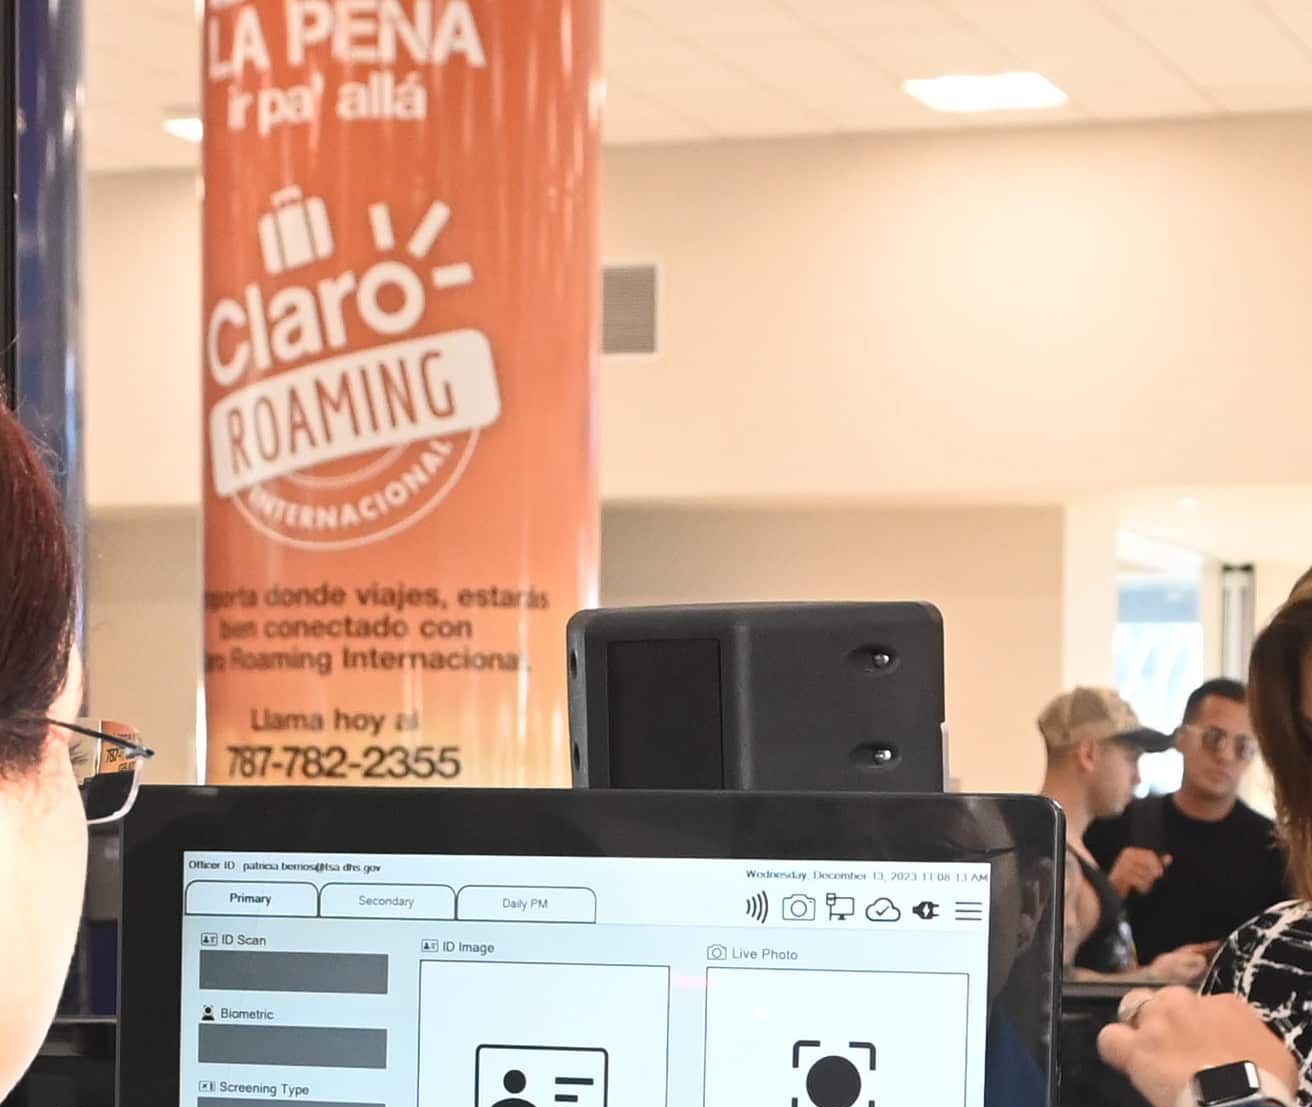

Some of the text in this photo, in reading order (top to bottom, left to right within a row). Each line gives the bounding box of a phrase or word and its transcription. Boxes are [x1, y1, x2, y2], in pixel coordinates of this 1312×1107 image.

[209, 4, 271, 80] LA
[336, 71, 427, 120] allá
[208, 261, 425, 386] Claro
[226, 350, 456, 476] ROAMING
[247, 439, 454, 530] INTERNACIONAL
[265, 581, 347, 607] donde
[357, 580, 448, 612] viajes,
[264, 614, 409, 639] conectado
[419, 618, 473, 638] con
[230, 646, 333, 675] Roaming
[250, 706, 323, 732] Llama
[332, 707, 386, 735] hoy
[227, 745, 462, 780] 787-782-2355
[813, 871, 867, 881] December
[971, 873, 989, 882] AM
[229, 892, 272, 907] Primary
[358, 893, 415, 910] Secondary
[502, 896, 549, 911] Daily PM
[221, 934, 267, 947] ID Scan
[442, 941, 496, 955] ID Image
[731, 947, 799, 961] Live Photo
[220, 1007, 275, 1021] Biometric
[219, 1081, 310, 1098] Screening Type
